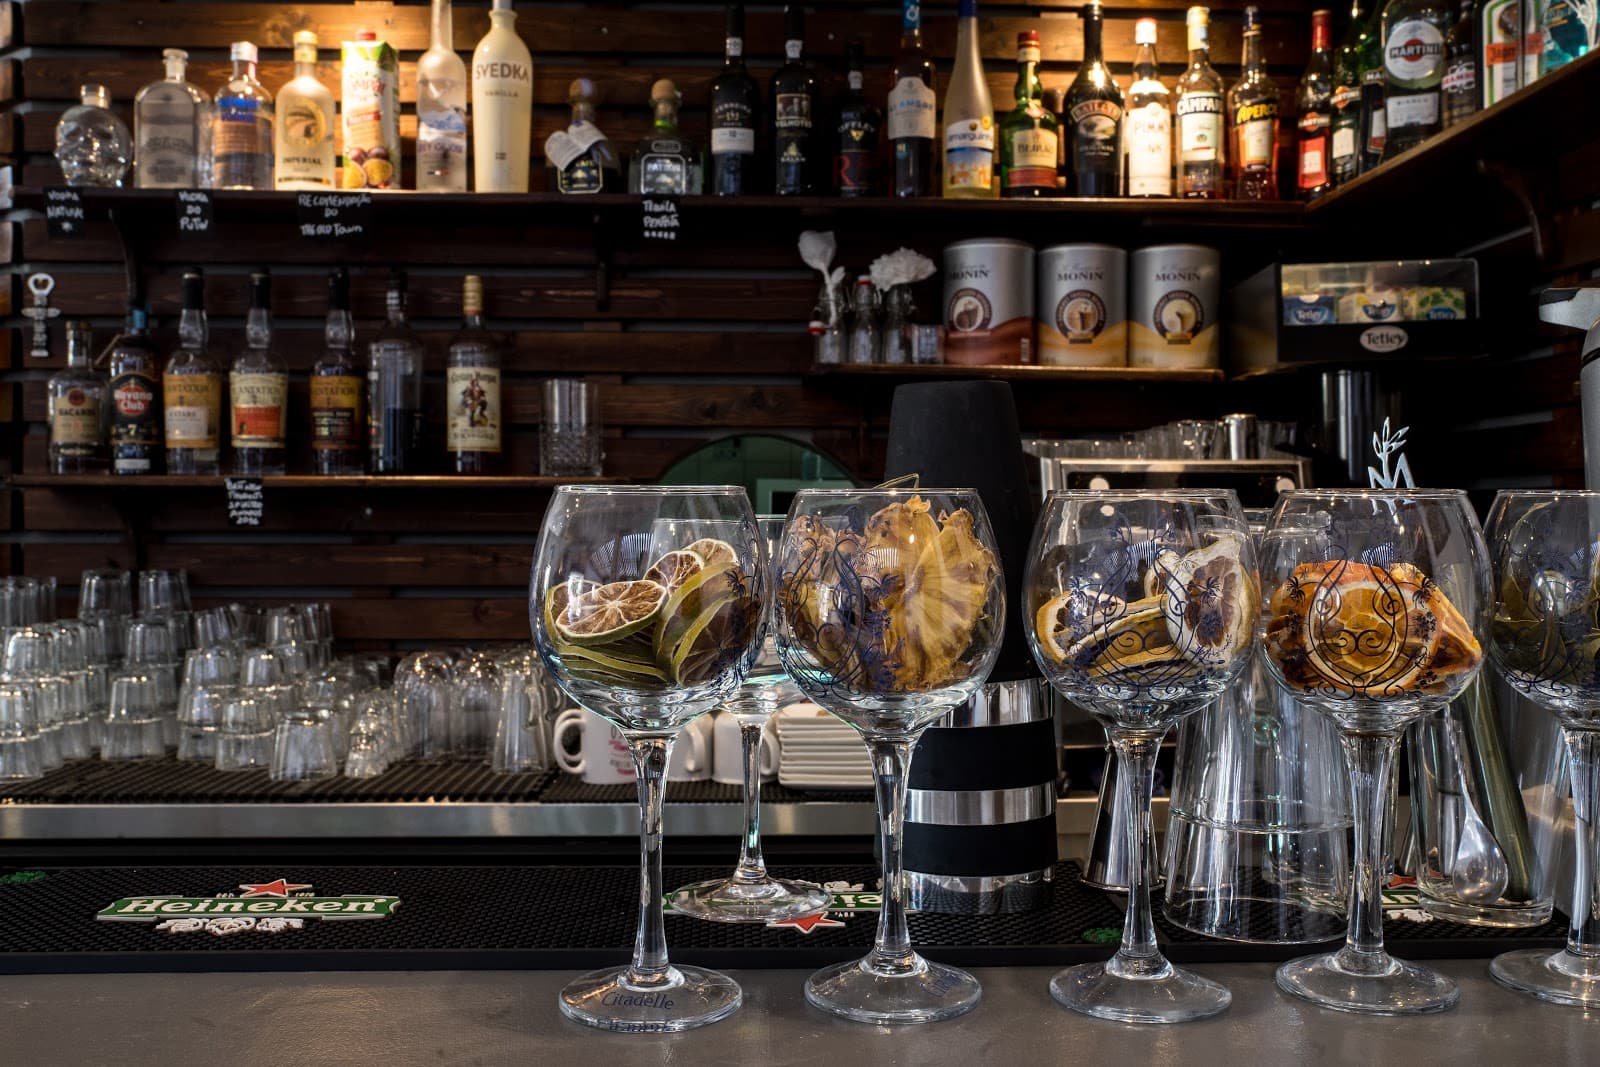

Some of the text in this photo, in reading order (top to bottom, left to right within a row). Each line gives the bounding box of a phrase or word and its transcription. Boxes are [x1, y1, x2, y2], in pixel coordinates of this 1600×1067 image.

[1390, 43, 1440, 58] MARTINI
[475, 61, 530, 82] SVEDKA
[324, 207, 339, 218] DO
[1057, 271, 1104, 281] MONIN
[1155, 271, 1201, 281] MONIN
[1365, 331, 1404, 346] Tetley
[122, 399, 144, 411] Club
[127, 423, 137, 437] 7
[116, 898, 378, 914] Heineken
[602, 991, 675, 1010] Citadelle
